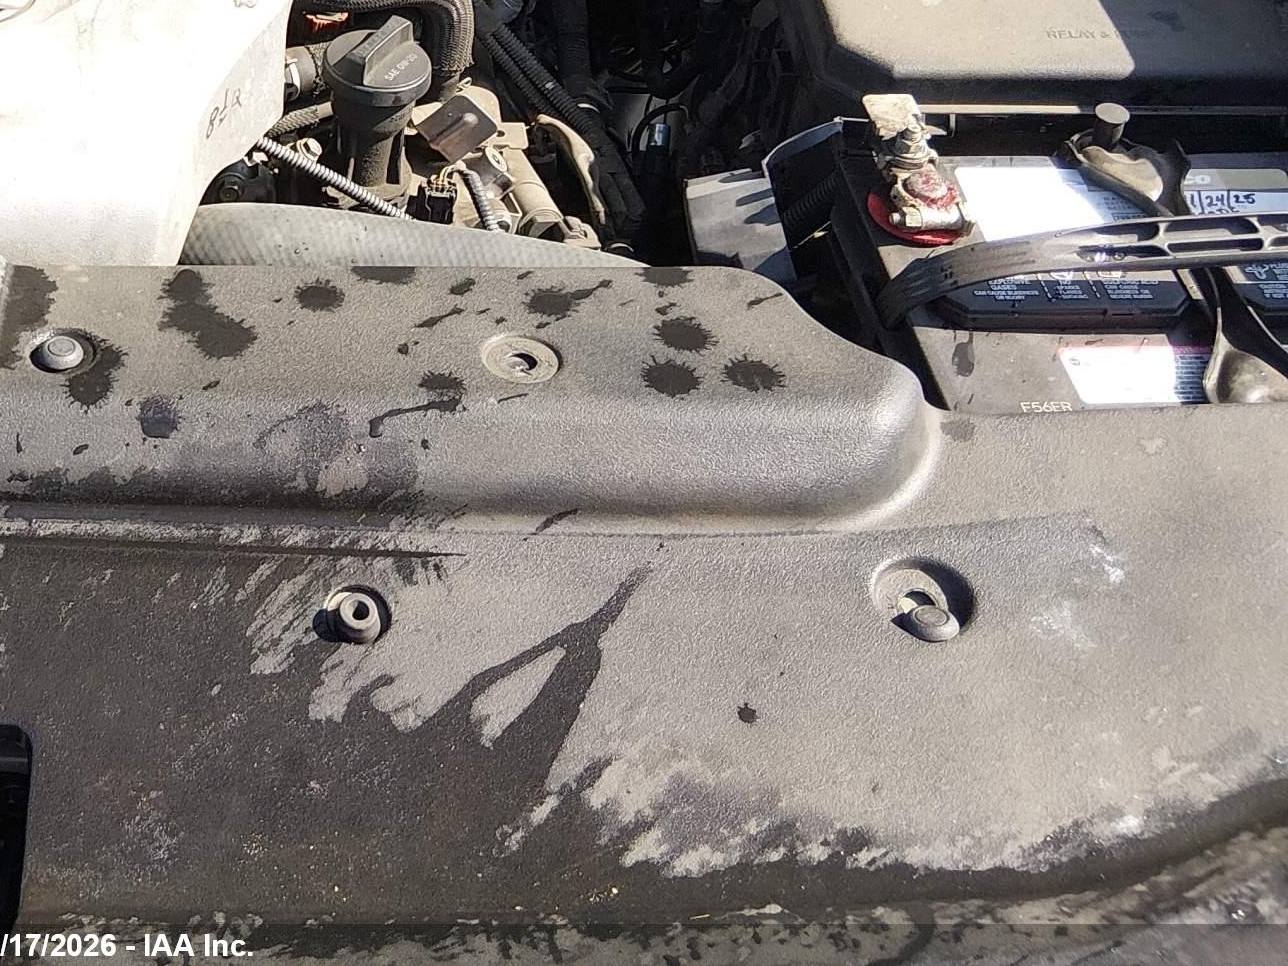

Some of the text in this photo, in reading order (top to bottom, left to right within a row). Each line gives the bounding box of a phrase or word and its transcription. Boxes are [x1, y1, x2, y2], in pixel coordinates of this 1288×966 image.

[1046, 30, 1096, 39] RELAY
[384, 53, 418, 81] SAE 0W-20
